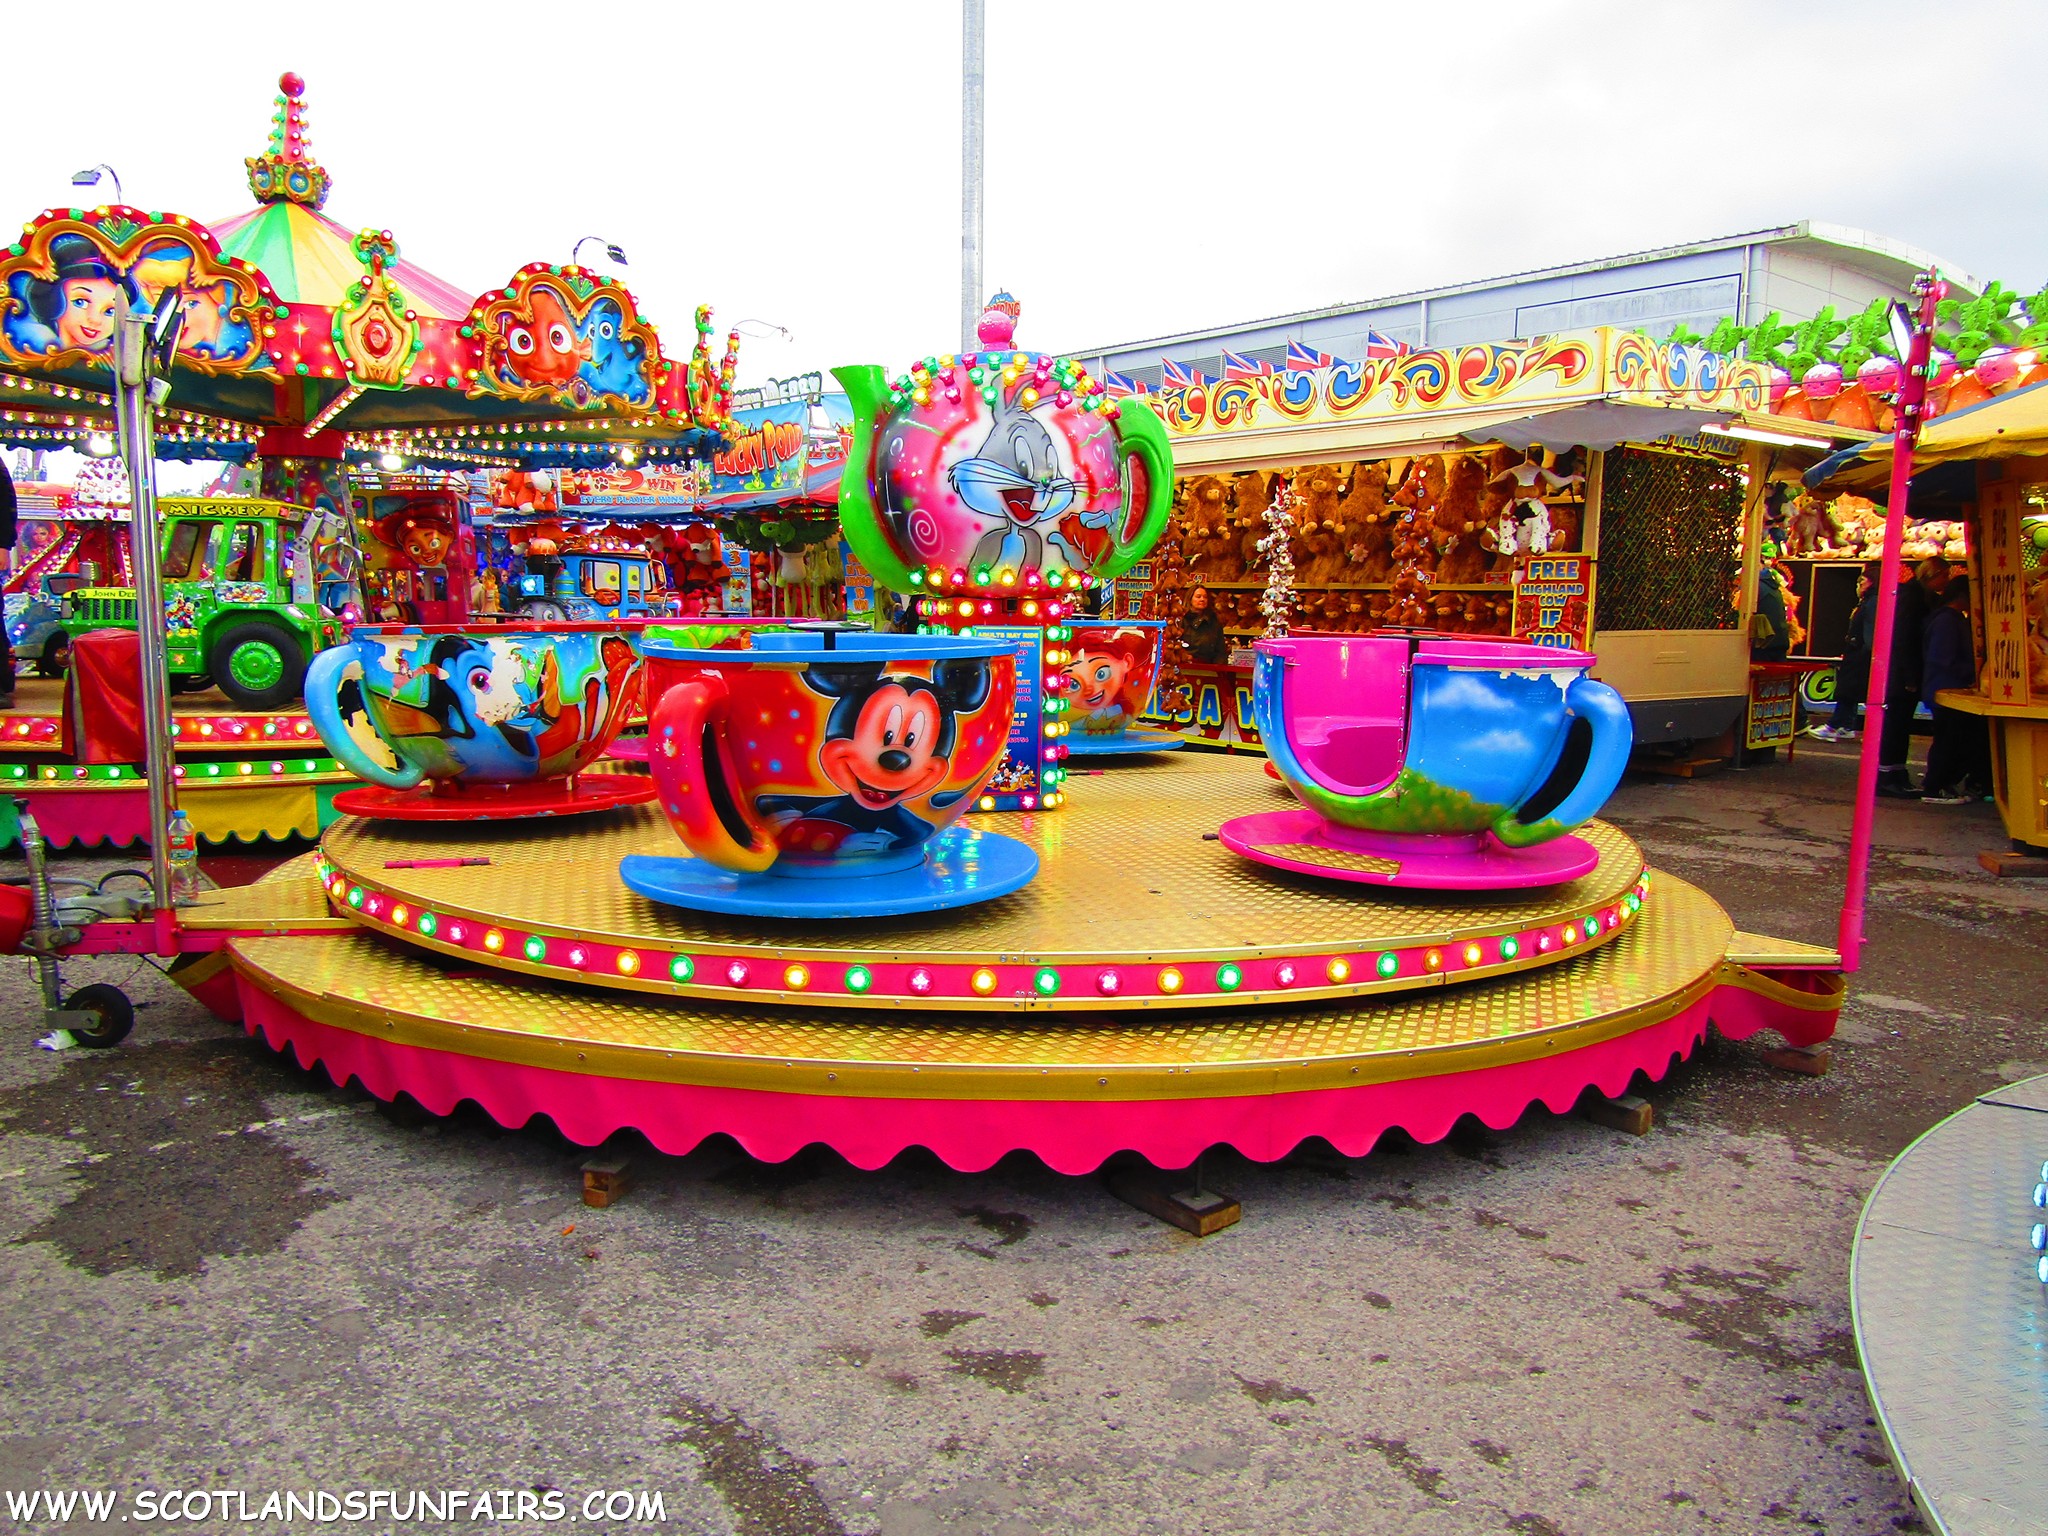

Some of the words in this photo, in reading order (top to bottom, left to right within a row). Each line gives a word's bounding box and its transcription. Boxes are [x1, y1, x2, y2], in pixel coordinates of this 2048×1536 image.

[762, 420, 803, 468] POND
[1701, 433, 1740, 456] PRIZE
[646, 478, 677, 492] WIN
[580, 495, 614, 505] EVERY
[616, 495, 656, 505] PLAYER
[659, 495, 685, 505] WINS
[168, 504, 265, 516] MICKEY
[728, 550, 742, 566] 3
[1528, 560, 1579, 580] FREE
[1117, 581, 1153, 592] HIGHLAND
[1520, 583, 1584, 596] HIGHLAND
[1990, 574, 2015, 614] PRIZE
[1128, 590, 1144, 599] COW
[1538, 594, 1567, 606] COW
[1128, 600, 1141, 615] IF
[1539, 608, 1562, 628] IF
[1526, 632, 1572, 650] YOU
[1995, 639, 2020, 679] STALL
